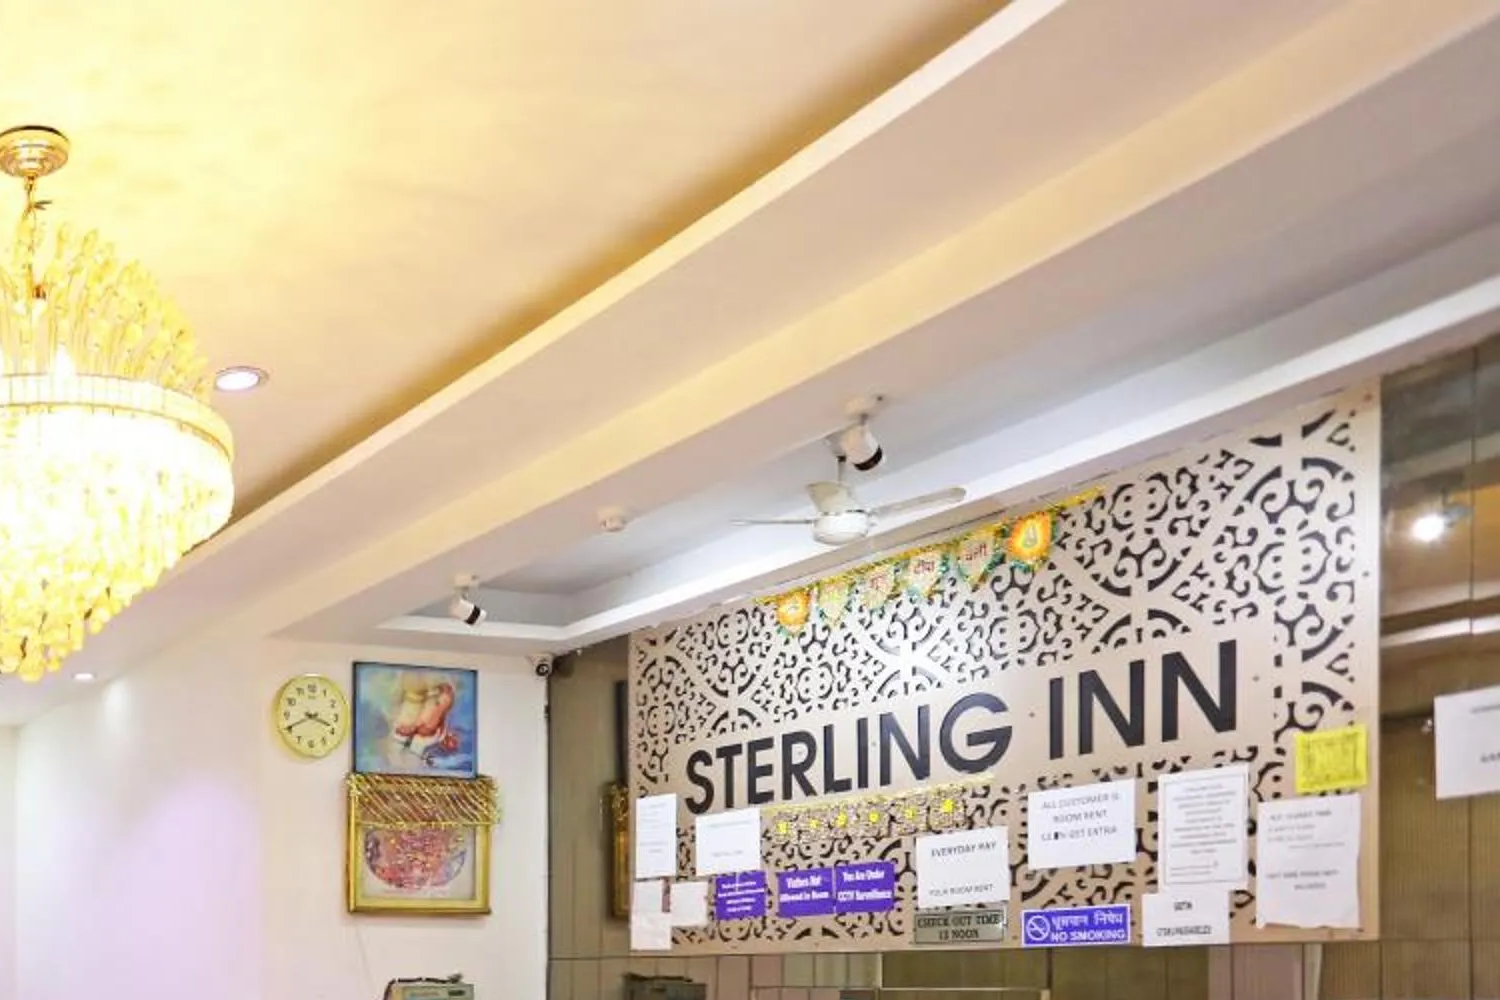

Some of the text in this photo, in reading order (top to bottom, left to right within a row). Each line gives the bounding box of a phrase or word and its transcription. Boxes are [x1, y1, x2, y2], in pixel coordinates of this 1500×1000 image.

[684, 692, 1013, 815] STERLING
[1049, 639, 1238, 760] INN
[931, 843, 976, 857] EVERYDAY
[917, 913, 1001, 929] CHECK OUT TIME
[951, 928, 980, 939] NOON
[1050, 928, 1125, 942] NO SMOKING
